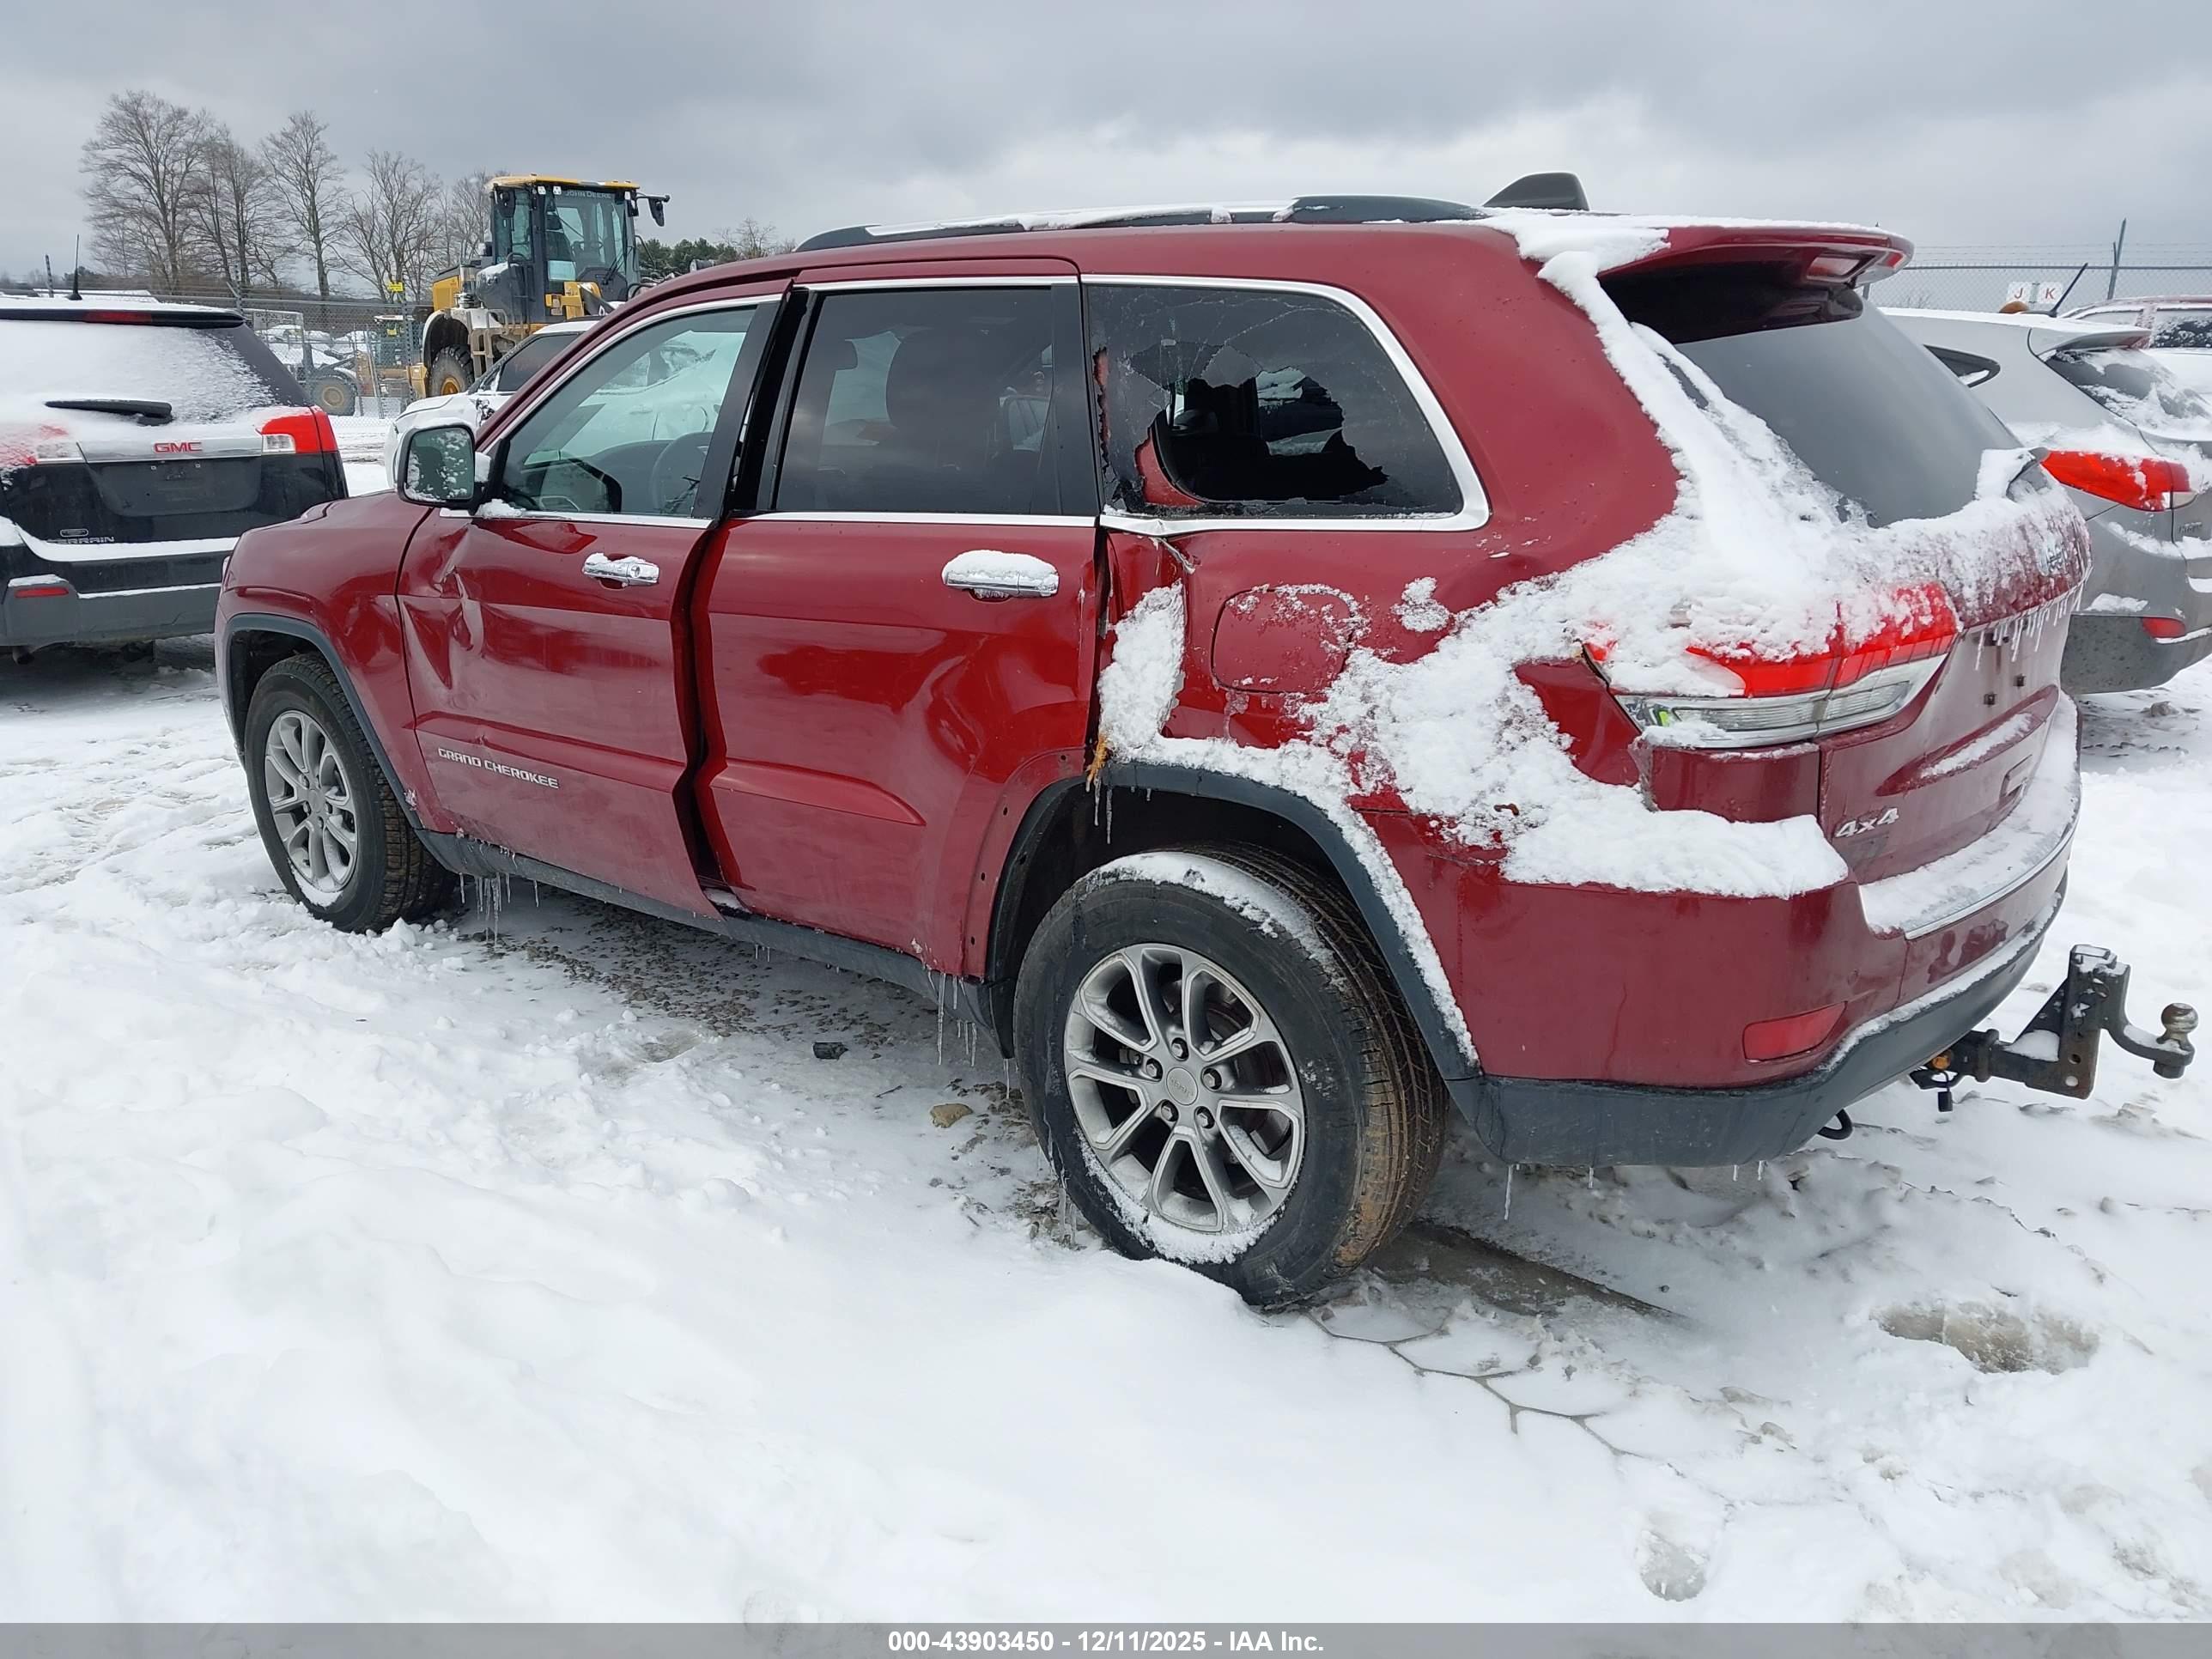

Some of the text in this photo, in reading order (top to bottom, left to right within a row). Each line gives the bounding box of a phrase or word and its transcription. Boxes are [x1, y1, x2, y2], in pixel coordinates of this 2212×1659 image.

[2014, 288, 2023, 299] J
[2045, 288, 2056, 299] K
[154, 441, 203, 453] GMC
[438, 747, 559, 789] GRAND CHEROKEE
[1835, 807, 1899, 838] 4x4
